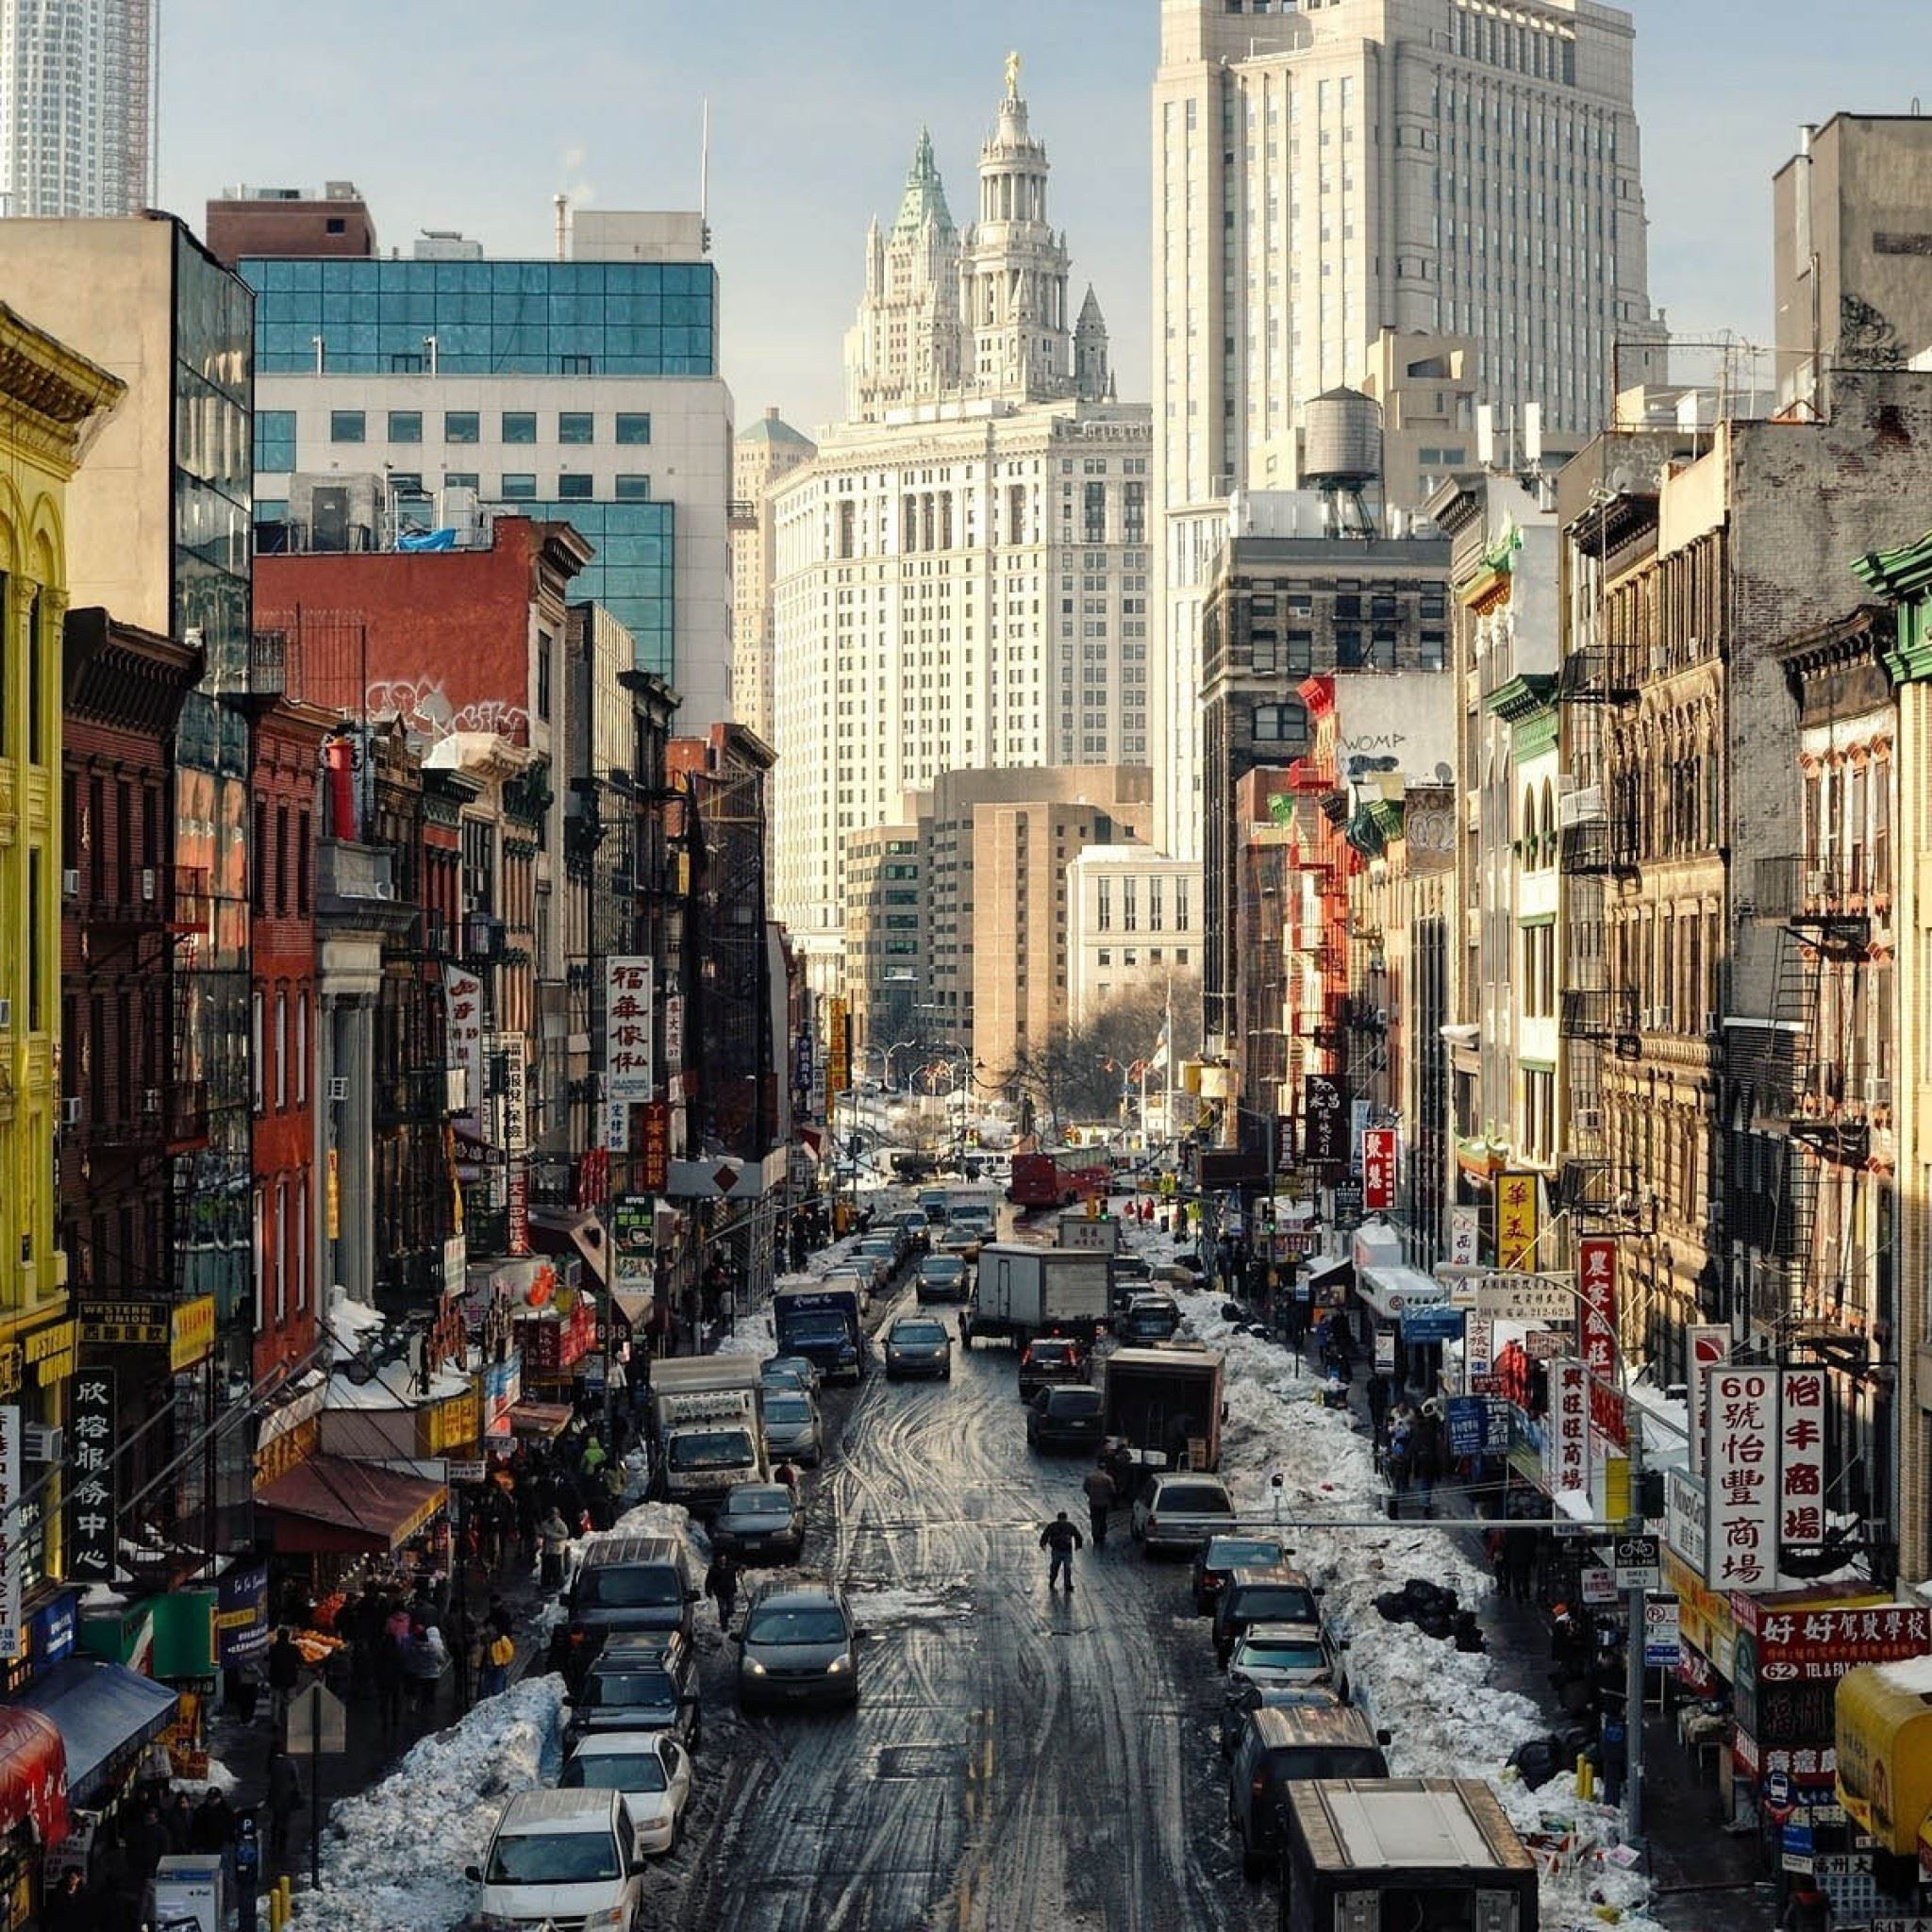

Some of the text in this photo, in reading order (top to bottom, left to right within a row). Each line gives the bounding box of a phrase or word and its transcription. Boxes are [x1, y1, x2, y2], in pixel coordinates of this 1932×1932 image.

[1342, 734, 1406, 752] WOMP
[610, 965, 648, 1074] 福華傢俬
[83, 1306, 151, 1314] WESTERN
[1561, 1368, 1585, 1490] 興旺旺商場
[1765, 1663, 1792, 1678] 62
